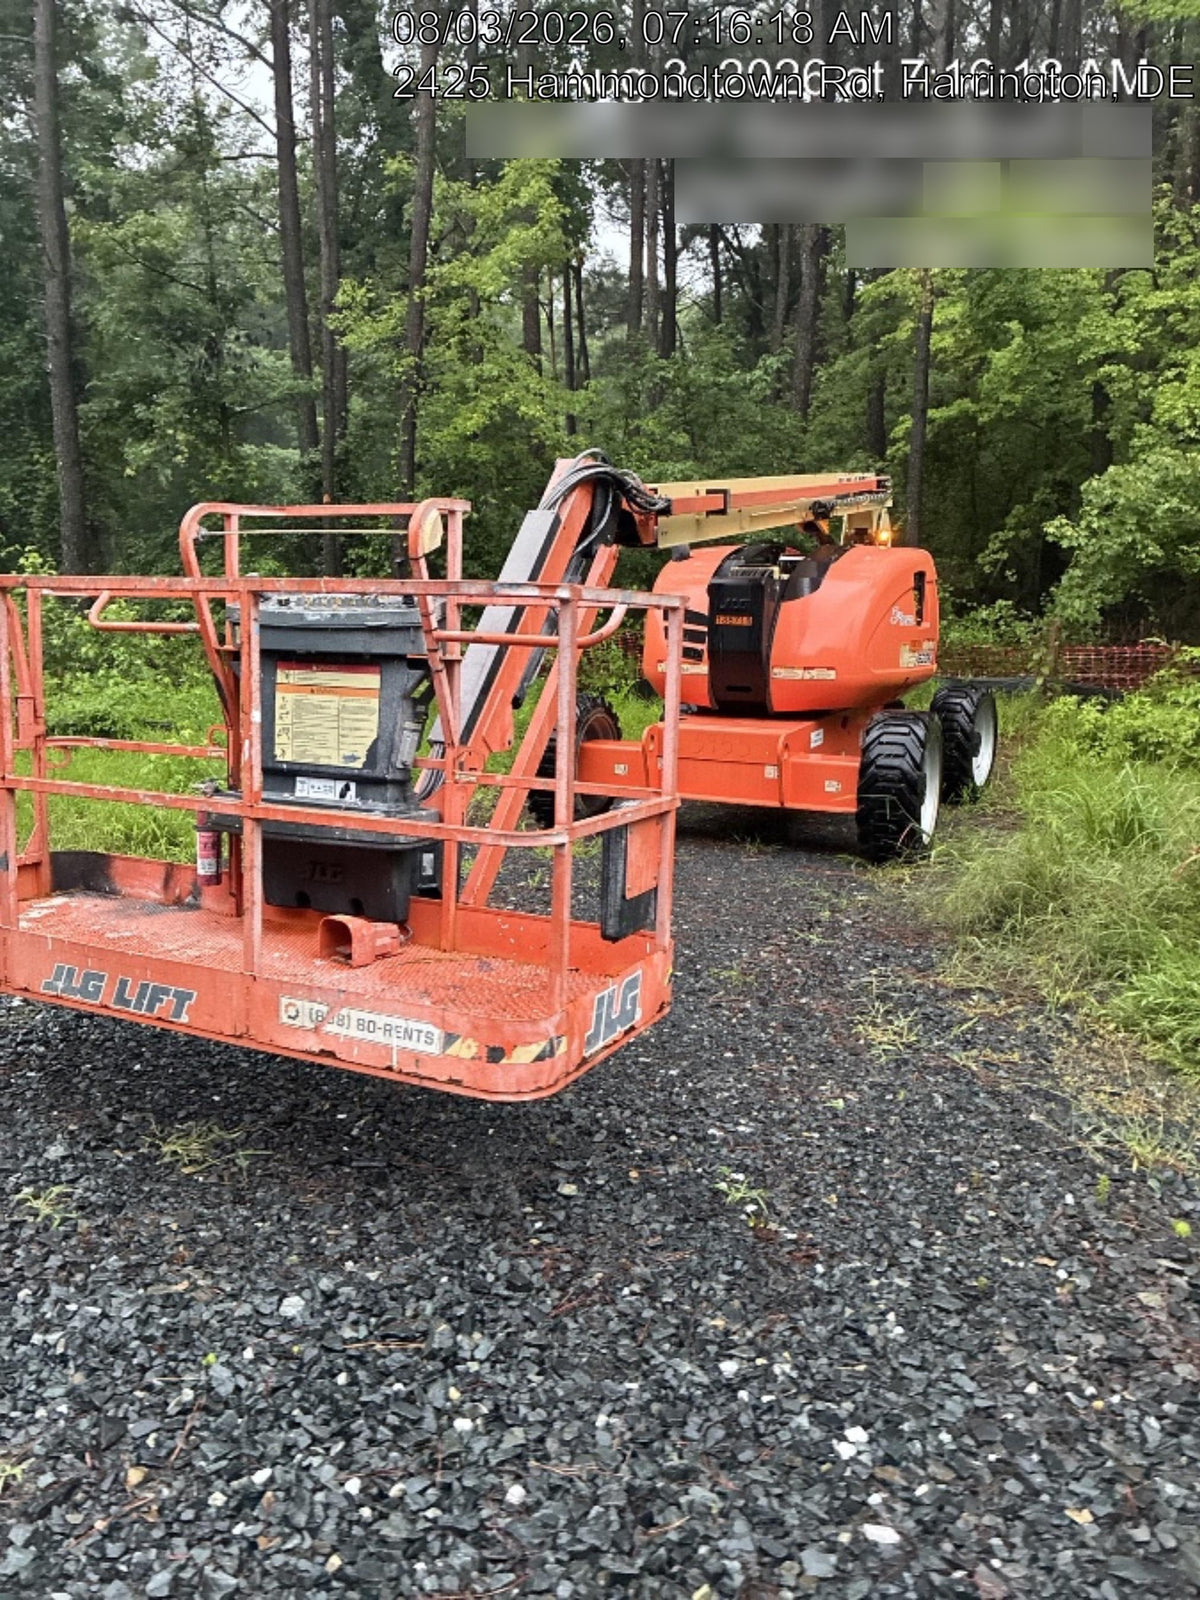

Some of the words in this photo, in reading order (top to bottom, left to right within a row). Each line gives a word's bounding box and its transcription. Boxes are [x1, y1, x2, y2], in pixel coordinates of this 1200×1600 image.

[41, 963, 107, 1003] JLG
[112, 976, 197, 1023] LIFT
[583, 969, 642, 1057] JLG
